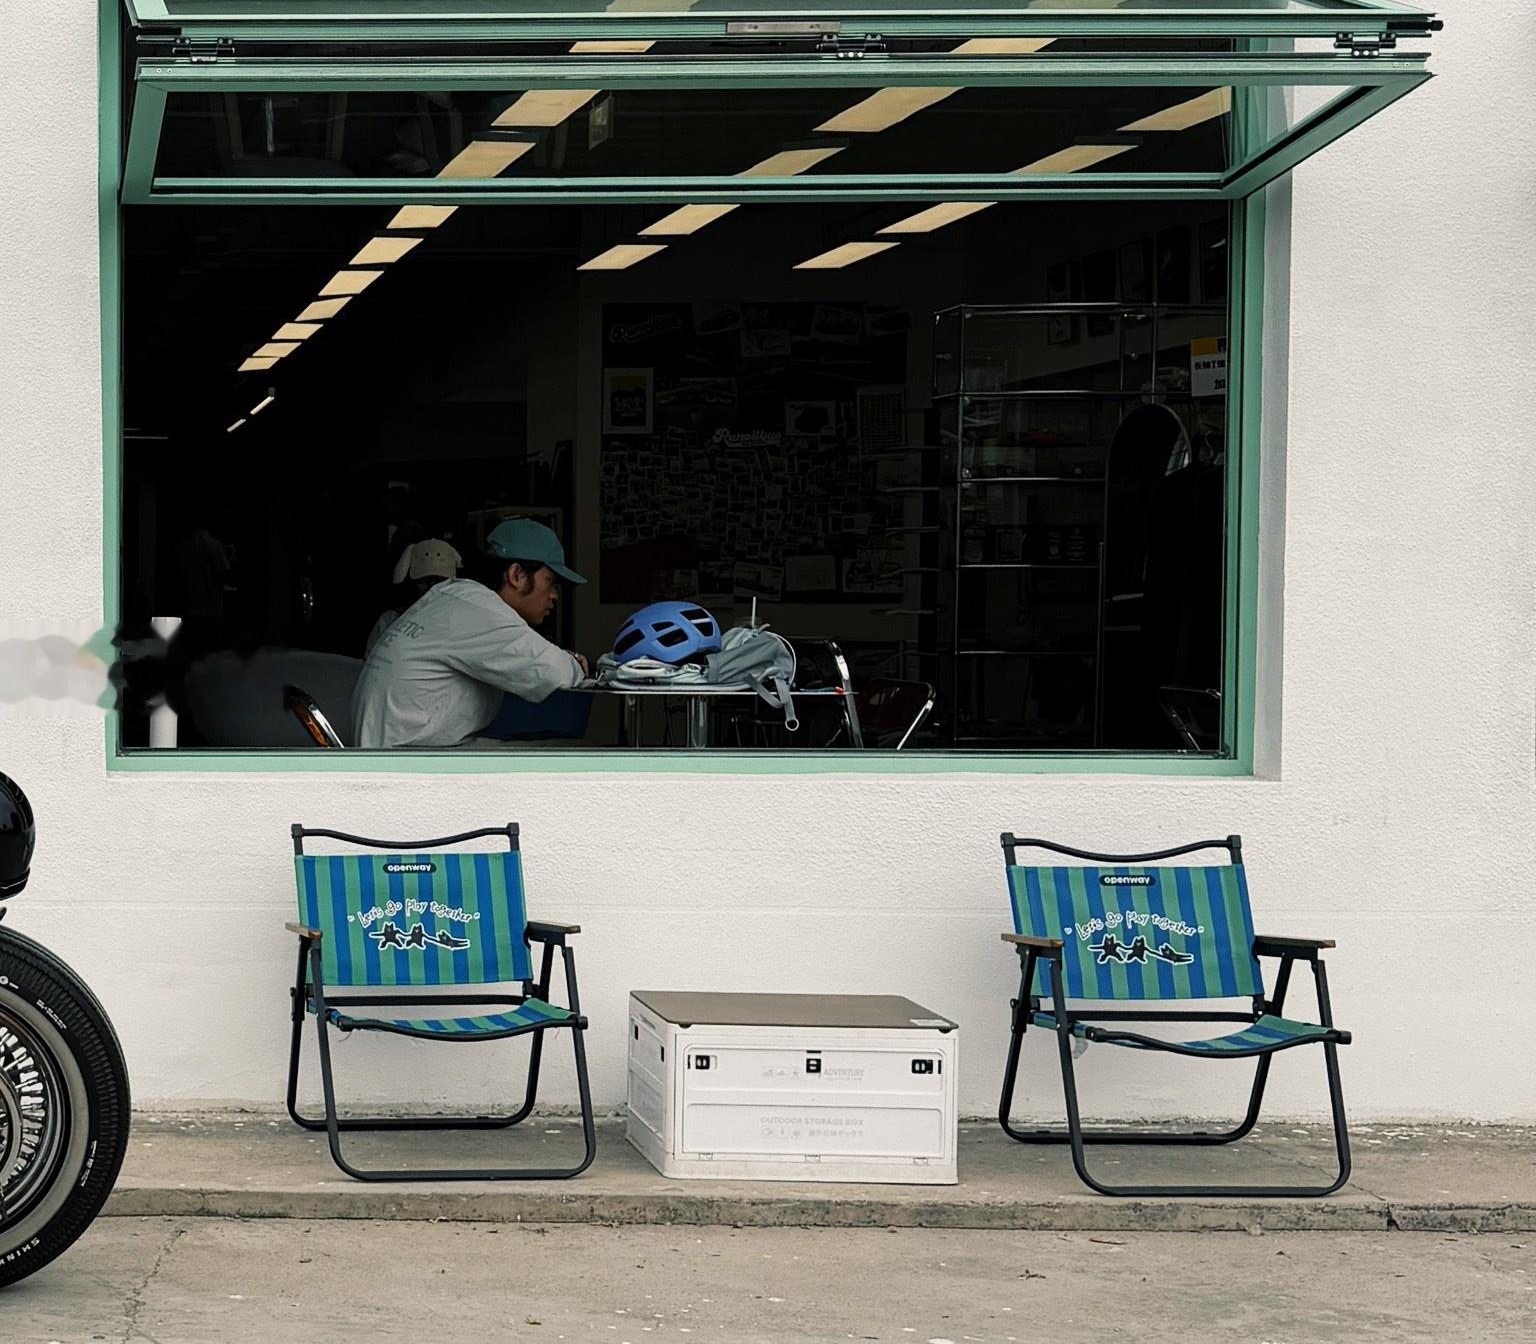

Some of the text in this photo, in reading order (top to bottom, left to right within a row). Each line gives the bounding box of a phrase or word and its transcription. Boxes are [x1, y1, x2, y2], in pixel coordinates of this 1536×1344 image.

[387, 864, 431, 873] openway
[1104, 876, 1150, 885] openway
[385, 900, 403, 916] go
[1105, 911, 1124, 928] go
